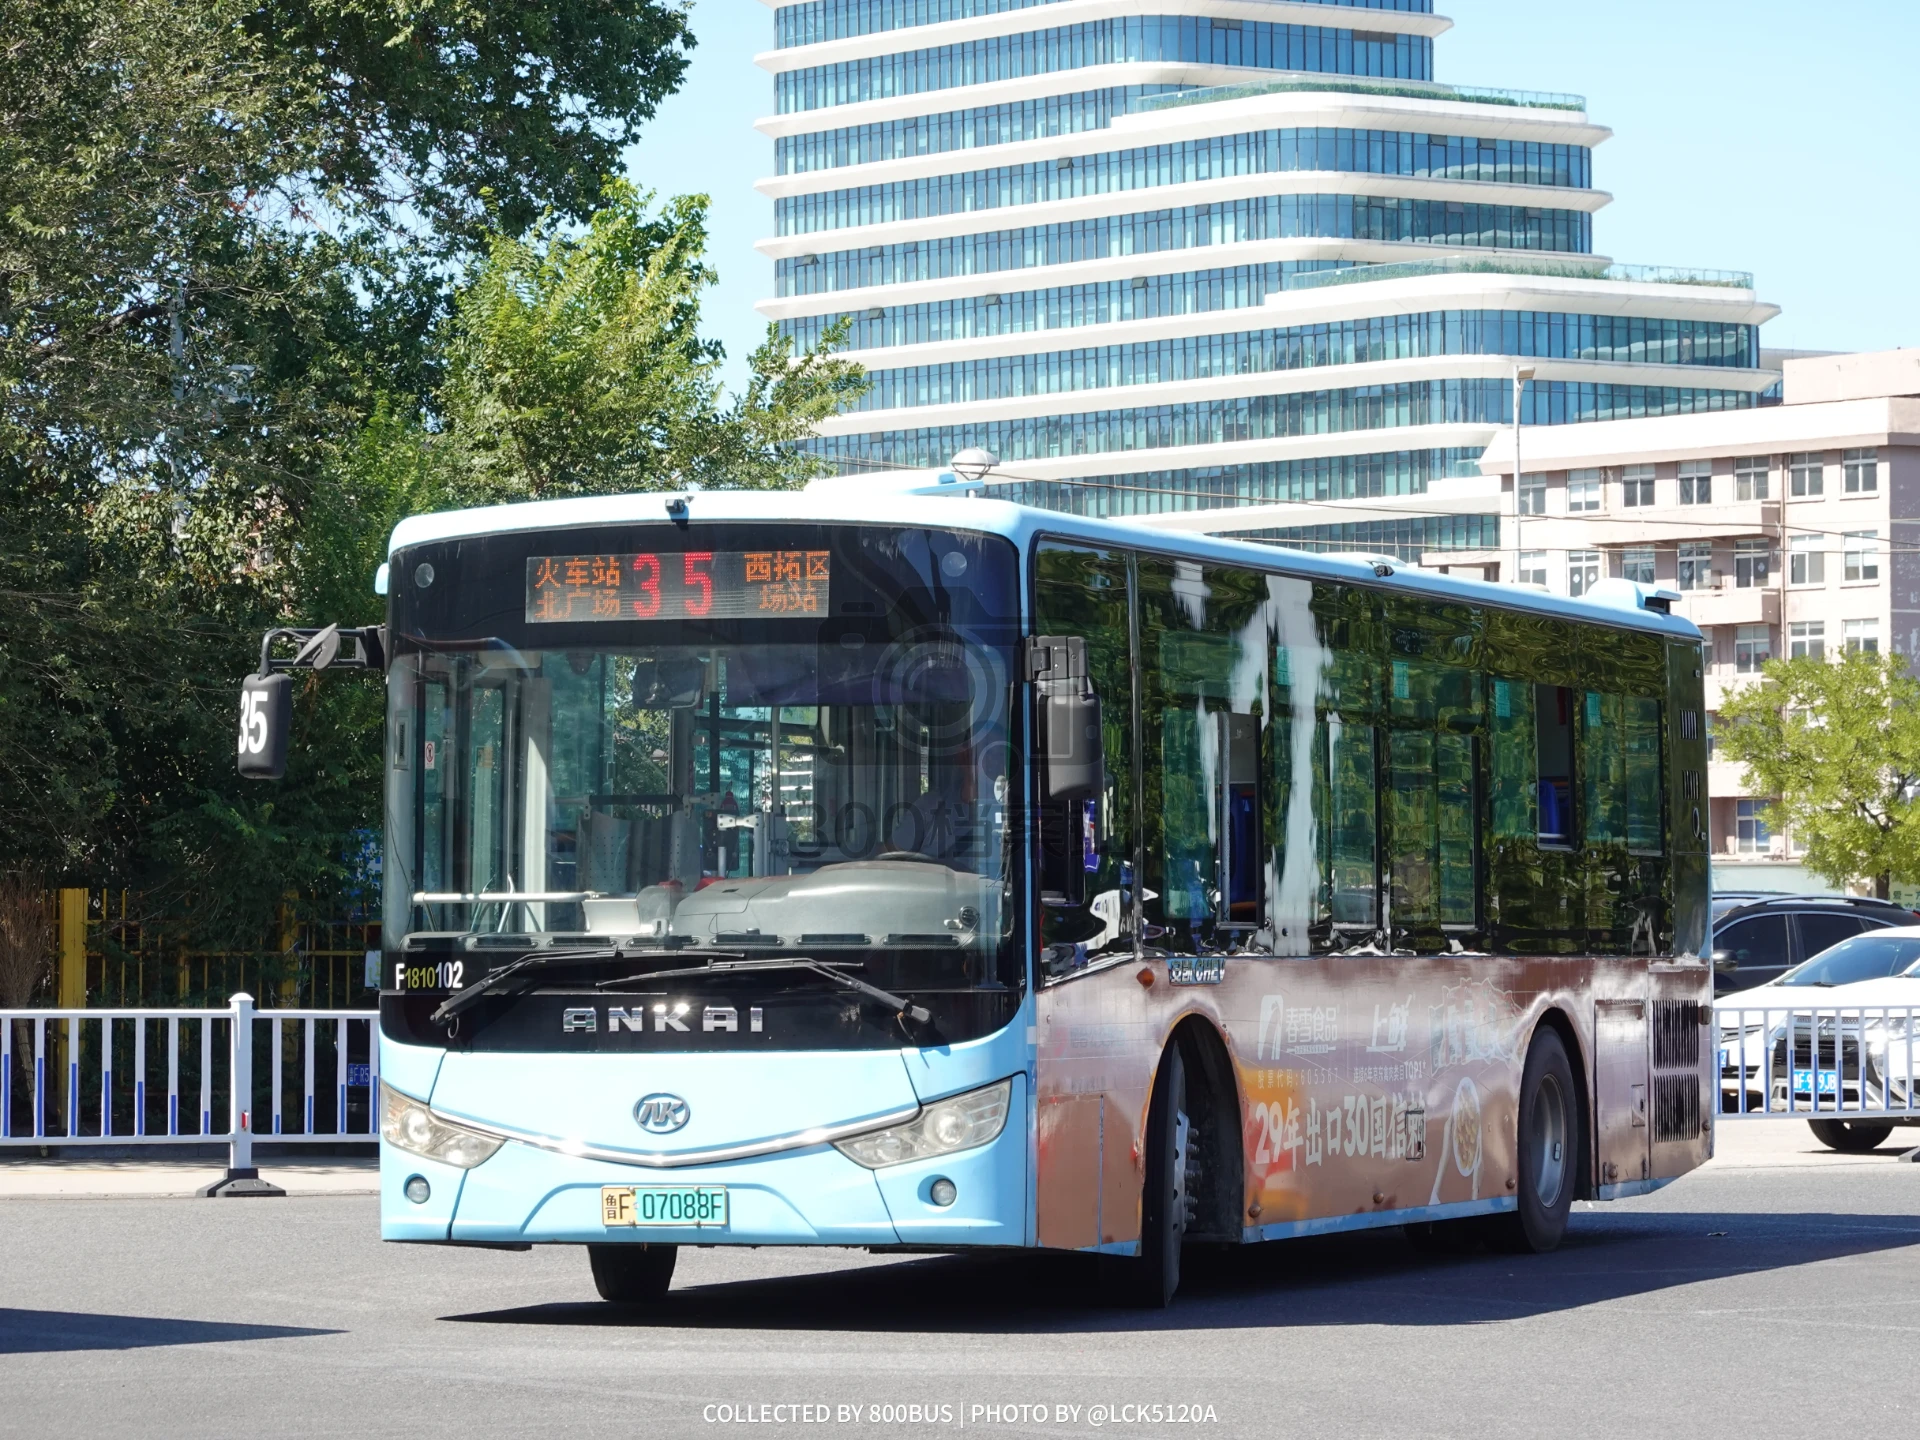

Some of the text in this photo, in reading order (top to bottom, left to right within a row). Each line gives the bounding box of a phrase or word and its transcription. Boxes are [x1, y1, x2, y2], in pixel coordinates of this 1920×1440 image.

[535, 557, 620, 588] 火车站
[744, 551, 829, 582] 西拓区
[535, 586, 620, 619] 北广场
[760, 581, 817, 612] 场站
[238, 690, 268, 754] 35
[396, 961, 464, 991] F1810102
[563, 1006, 764, 1033] ANKAI
[1286, 1006, 1338, 1043] 春雪食品
[1366, 993, 1413, 1052] 上鲜
[1255, 1091, 1427, 1172] 29年出口30国信赖
